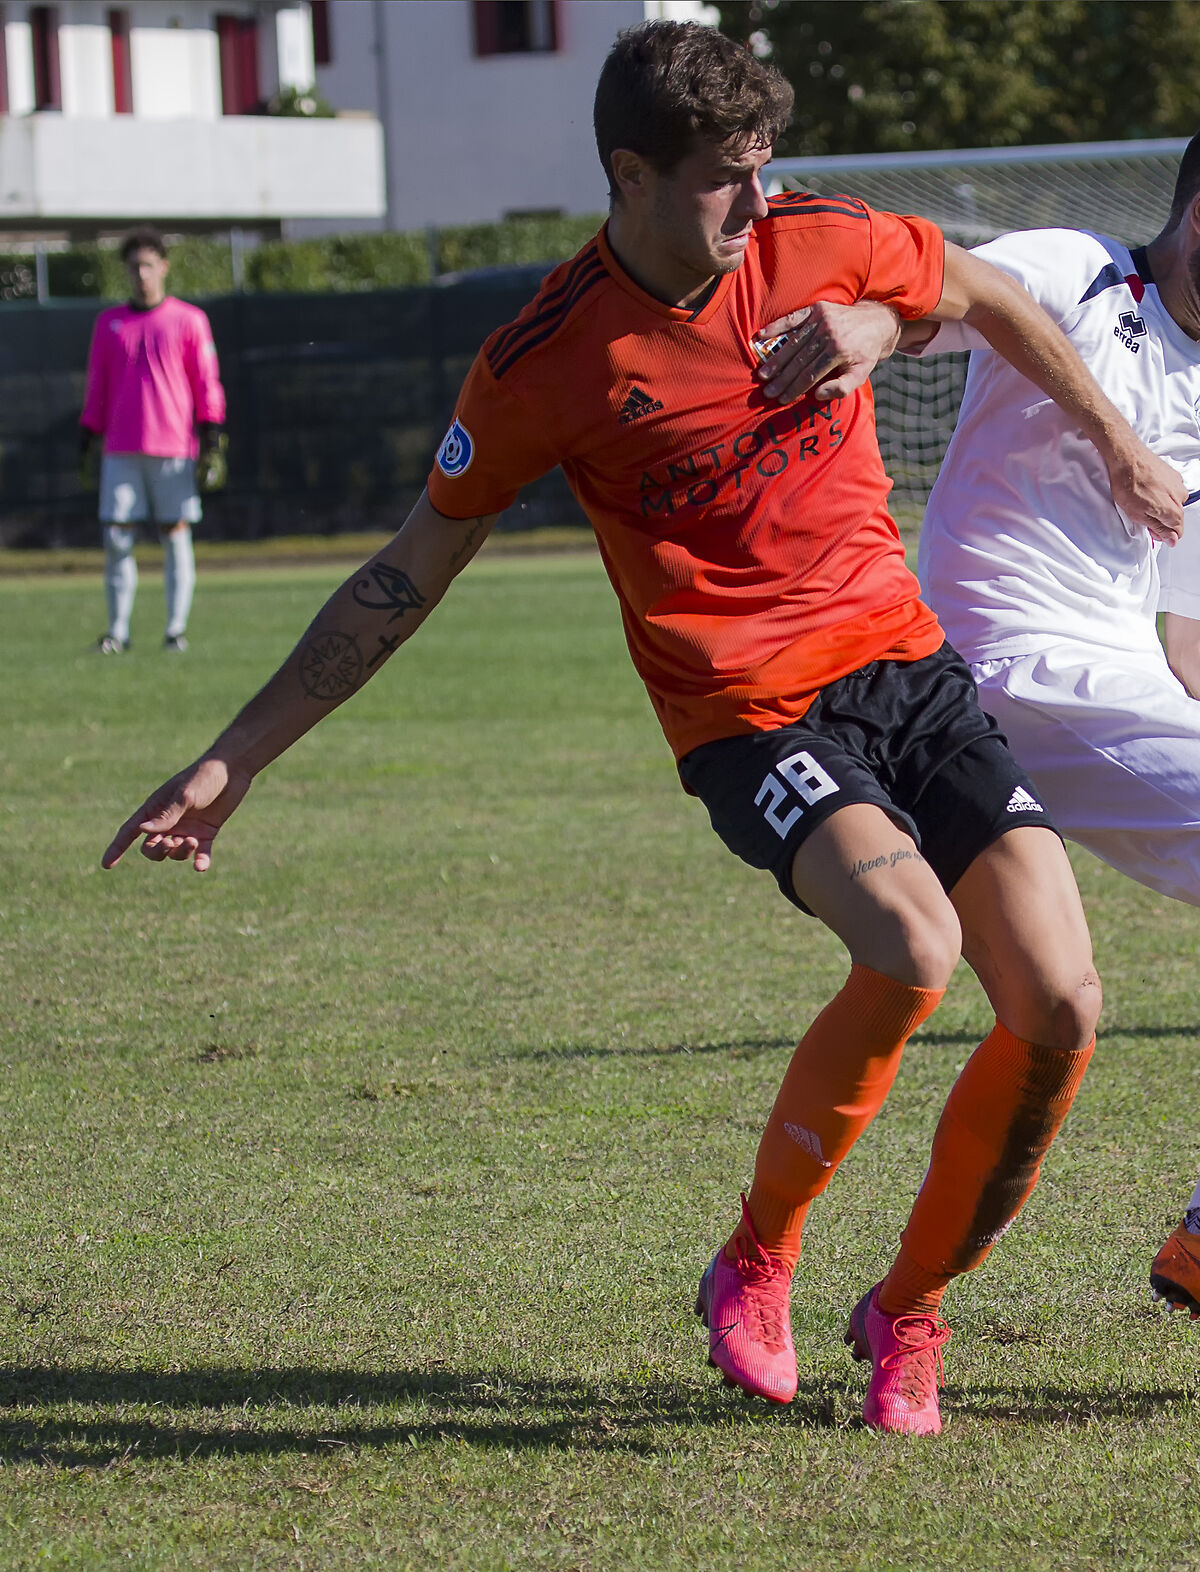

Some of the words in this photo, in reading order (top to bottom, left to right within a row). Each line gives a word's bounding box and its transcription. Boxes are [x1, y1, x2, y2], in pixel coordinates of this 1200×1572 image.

[1113, 326, 1140, 354] errea
[618, 399, 664, 425] adidas
[639, 418, 843, 518] MOTORS
[753, 750, 840, 840] 28
[1006, 801, 1044, 813] adidas
[850, 856, 888, 881] Never
[890, 848, 912, 868] give
